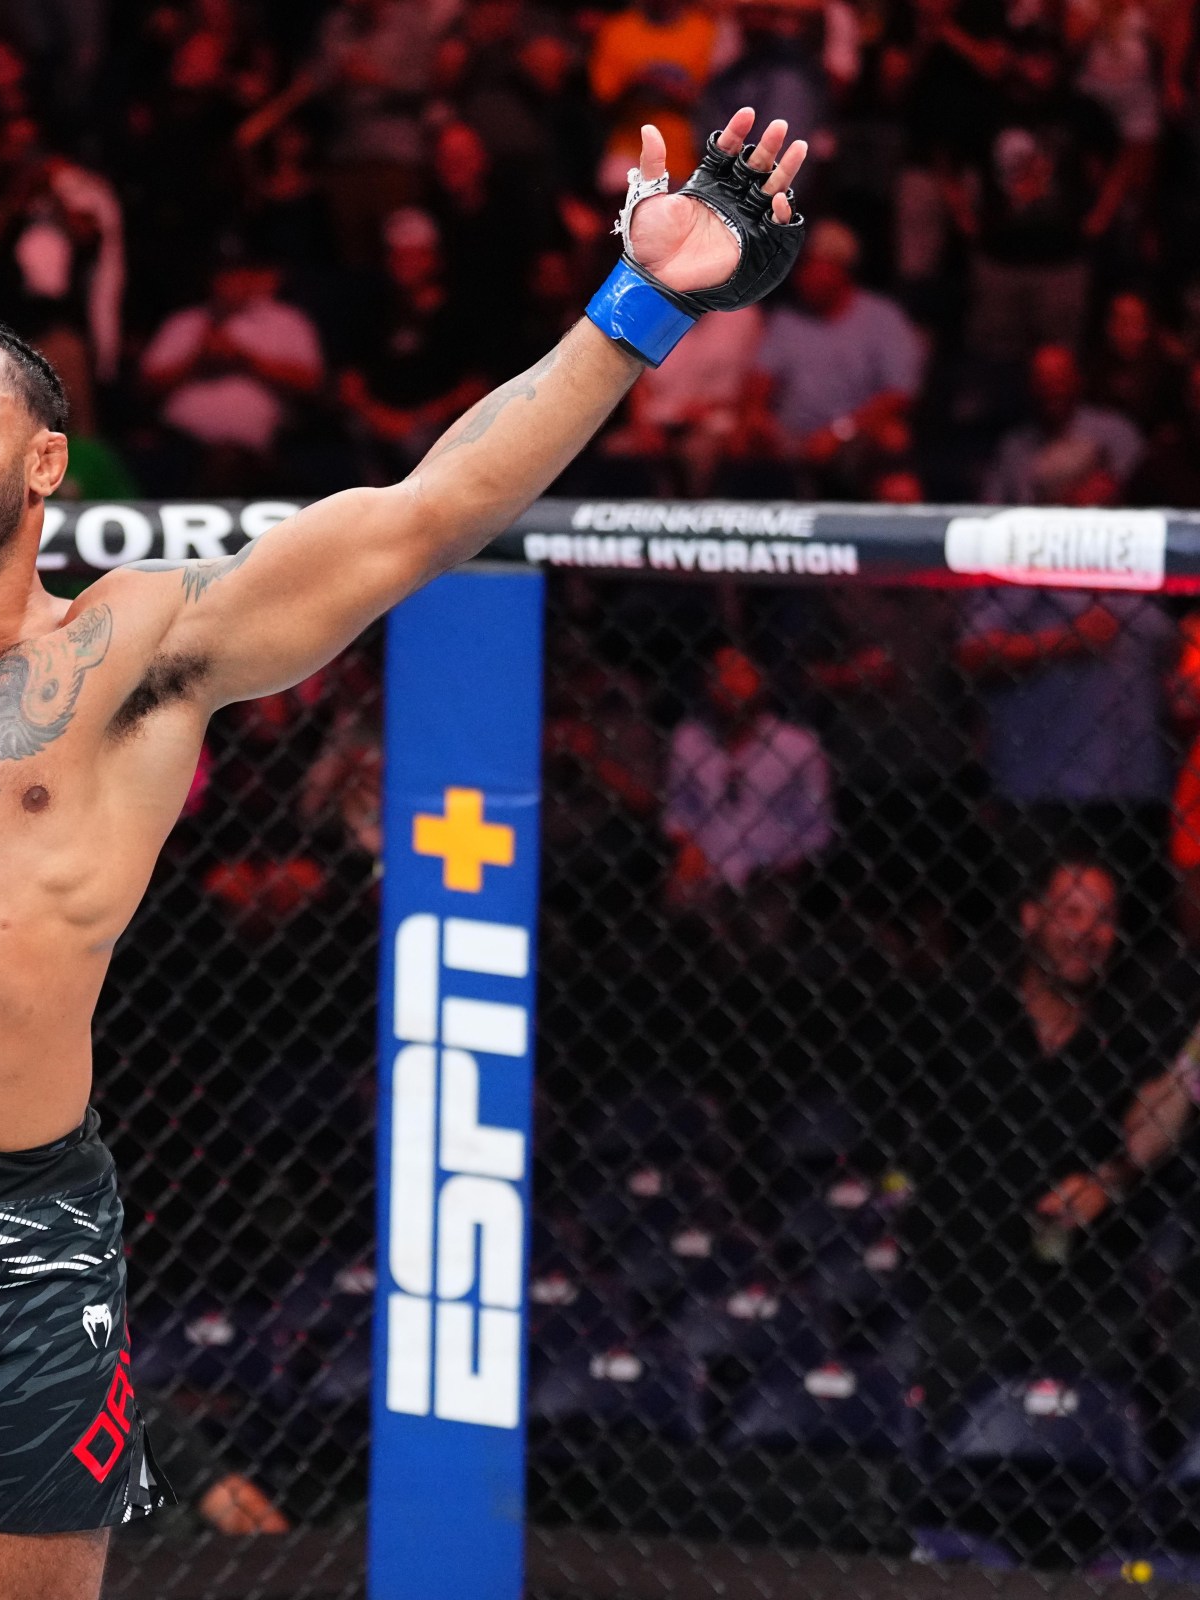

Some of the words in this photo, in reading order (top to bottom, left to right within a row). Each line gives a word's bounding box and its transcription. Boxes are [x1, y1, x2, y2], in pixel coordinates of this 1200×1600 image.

[571, 503, 816, 537] #DRINKPRIME
[523, 532, 643, 568] PRIME
[648, 537, 860, 576] HYDRATION
[1027, 517, 1134, 576] PRIME
